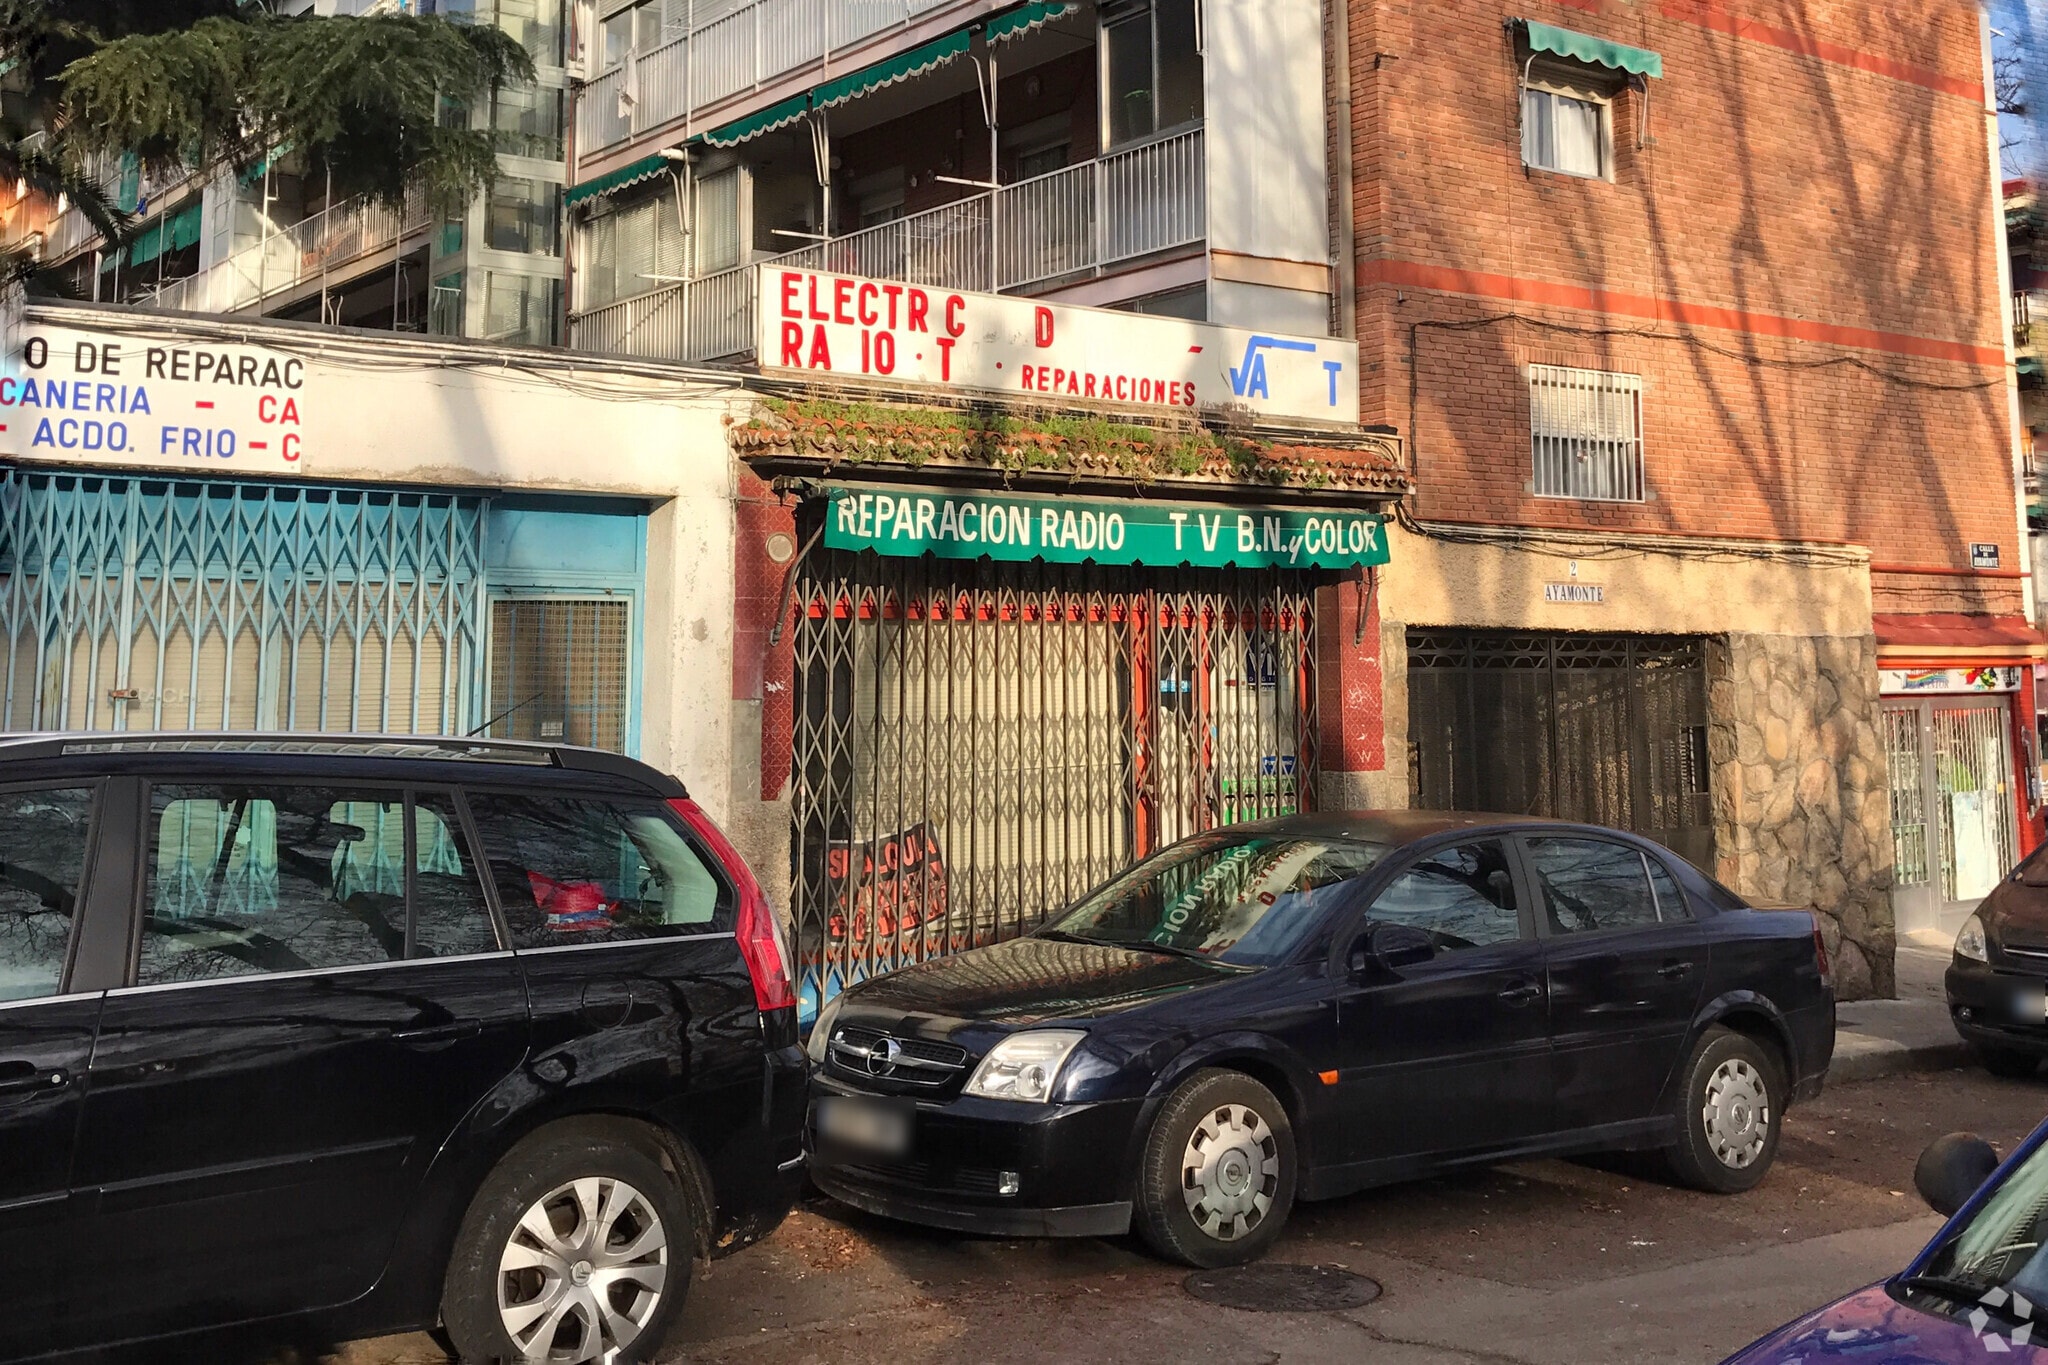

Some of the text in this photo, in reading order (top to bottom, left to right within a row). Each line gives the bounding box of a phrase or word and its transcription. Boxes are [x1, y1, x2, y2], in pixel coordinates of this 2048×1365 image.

[75, 341, 121, 376] DE
[146, 347, 303, 390] REPARAC
[1022, 364, 1195, 407] REPARACIONES
[258, 395, 300, 425] CA
[32, 417, 135, 453] ACDO.
[161, 425, 236, 458] FRIO
[837, 494, 1030, 546] REPARACION
[1041, 508, 1125, 551] RADIO
[1305, 517, 1378, 555] COLOR
[1570, 561, 1577, 576] 2
[1545, 585, 1603, 601] AYAMONTE
